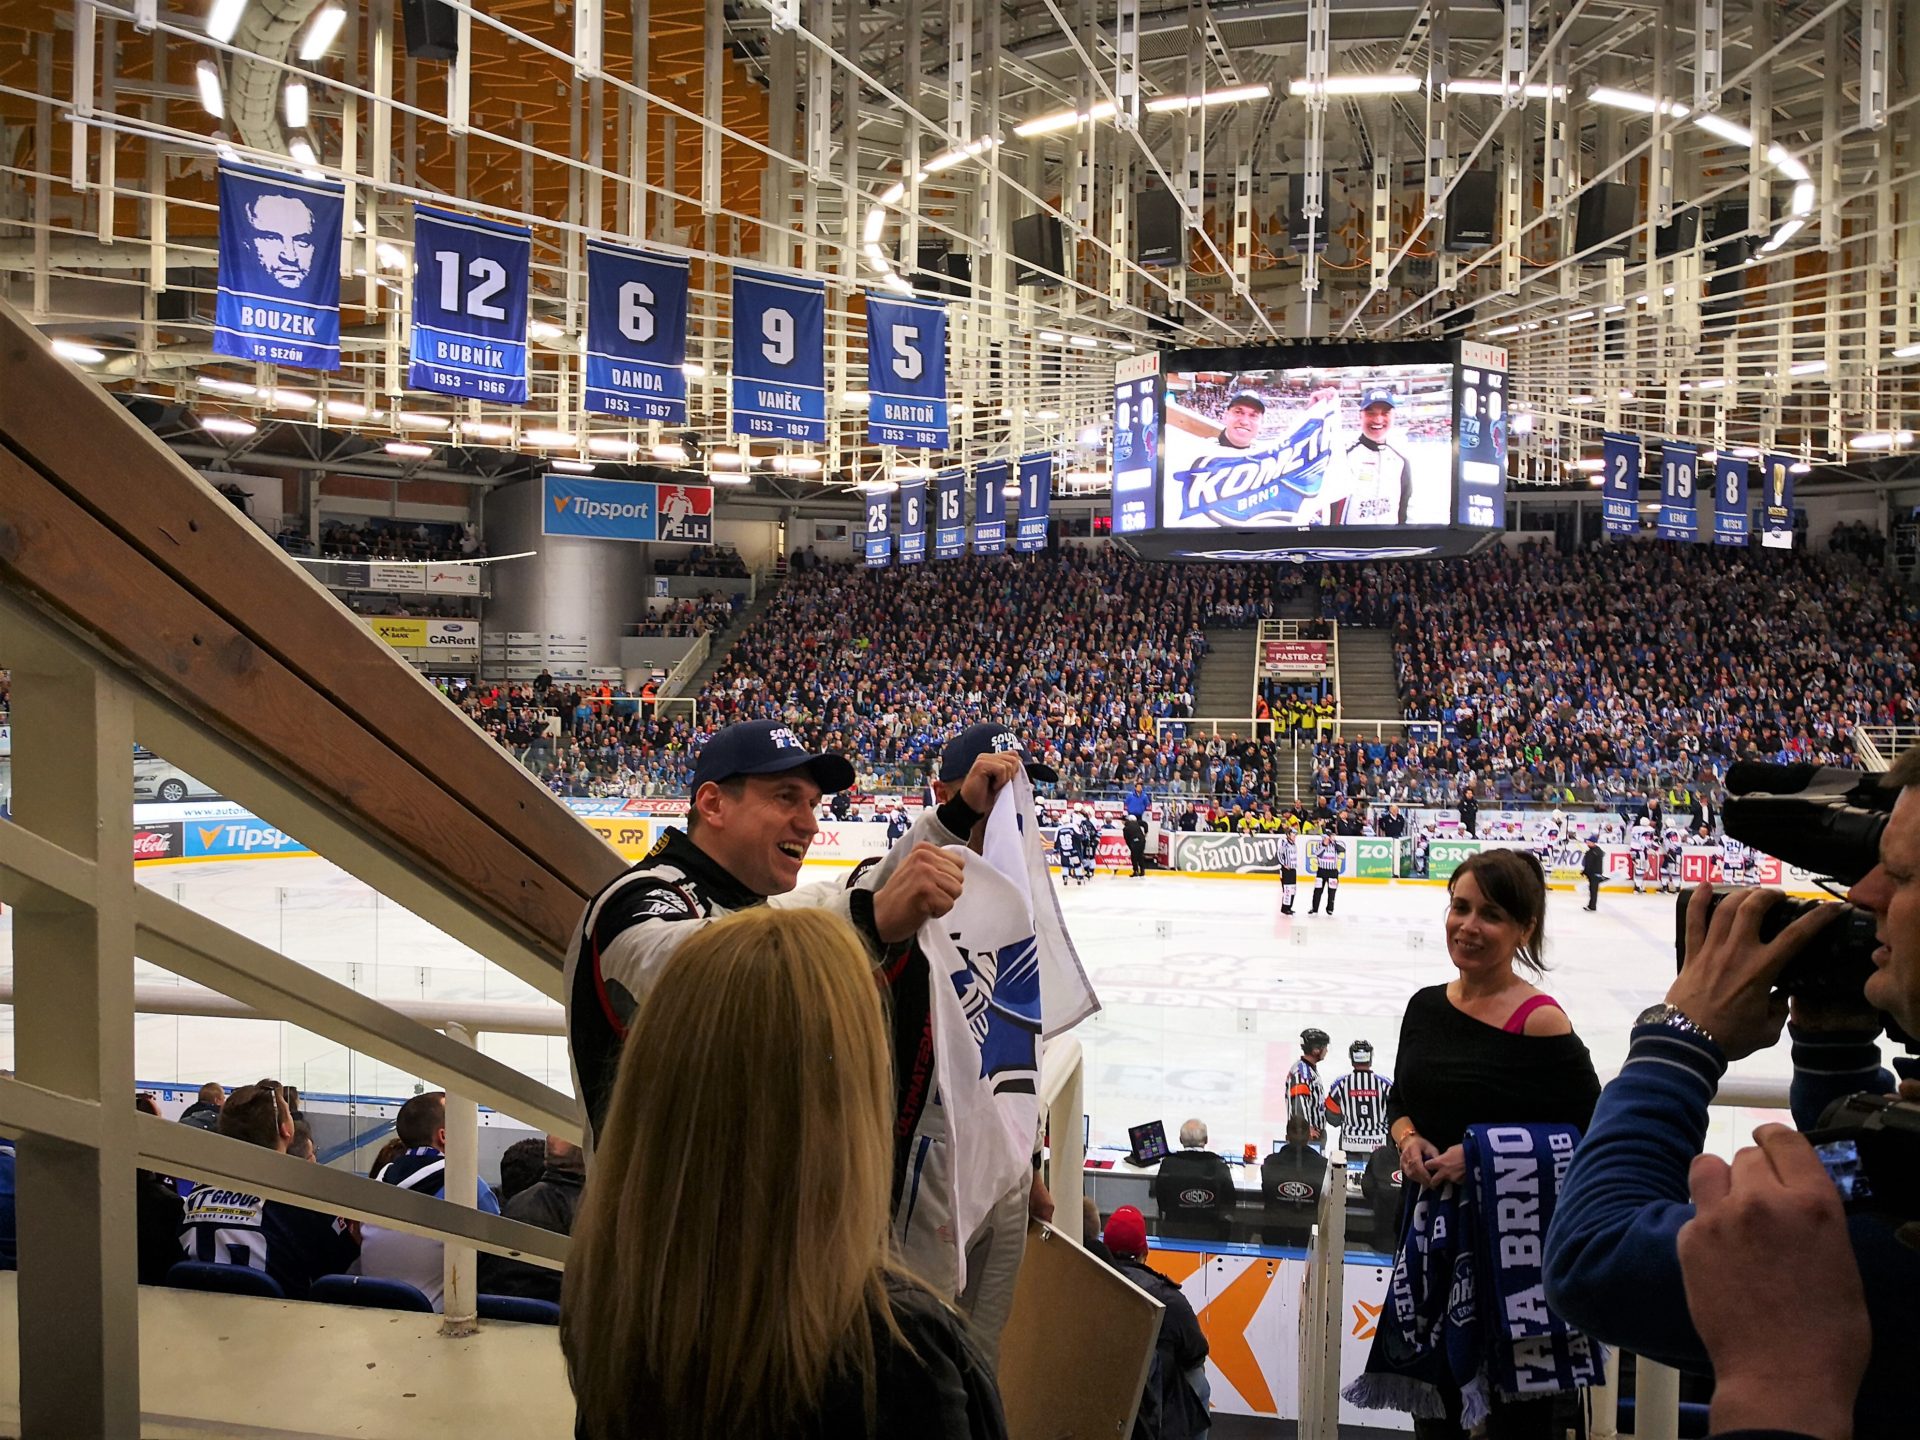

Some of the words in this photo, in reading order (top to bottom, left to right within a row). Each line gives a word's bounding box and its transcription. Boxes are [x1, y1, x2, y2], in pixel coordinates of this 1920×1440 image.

[435, 250, 507, 321] 12
[241, 305, 316, 337] BOUZEK
[618, 280, 655, 342] 6
[761, 307, 795, 365] 9
[253, 344, 267, 357] 13
[270, 346, 303, 362] SEZÓN
[437, 339, 504, 370] BUBNÍK
[891, 324, 923, 380] 5
[433, 372, 461, 388] 1953
[478, 378, 506, 394] 1966
[611, 367, 663, 392] DANDA
[604, 397, 630, 412] 1953
[645, 401, 671, 417] 1967
[758, 388, 802, 412] VANĚK
[884, 402, 934, 424] BARTOŇ
[750, 418, 773, 433] 1953
[786, 422, 810, 437] 1967
[882, 428, 904, 441] 1953
[916, 431, 937, 444] 1962
[1615, 454, 1627, 490] 2
[1666, 462, 1692, 498] 19
[985, 481, 994, 514] 1
[1029, 474, 1038, 508] 1
[1237, 484, 1280, 512] BRNO
[1726, 471, 1738, 504] 8
[574, 496, 649, 520] Tipsport
[868, 503, 887, 533] 25
[908, 497, 918, 526] 6
[941, 489, 959, 520] 15
[672, 523, 708, 540] ELH
[429, 635, 476, 646] CARent
[618, 828, 644, 845] SPP
[1184, 834, 1278, 873] Starobrn
[1360, 1104, 1368, 1115] 8
[211, 1189, 261, 1209] GROUP
[1185, 1190, 1209, 1203] BISON
[1284, 1182, 1308, 1197] BISON
[1487, 1127, 1542, 1269] BRNO
